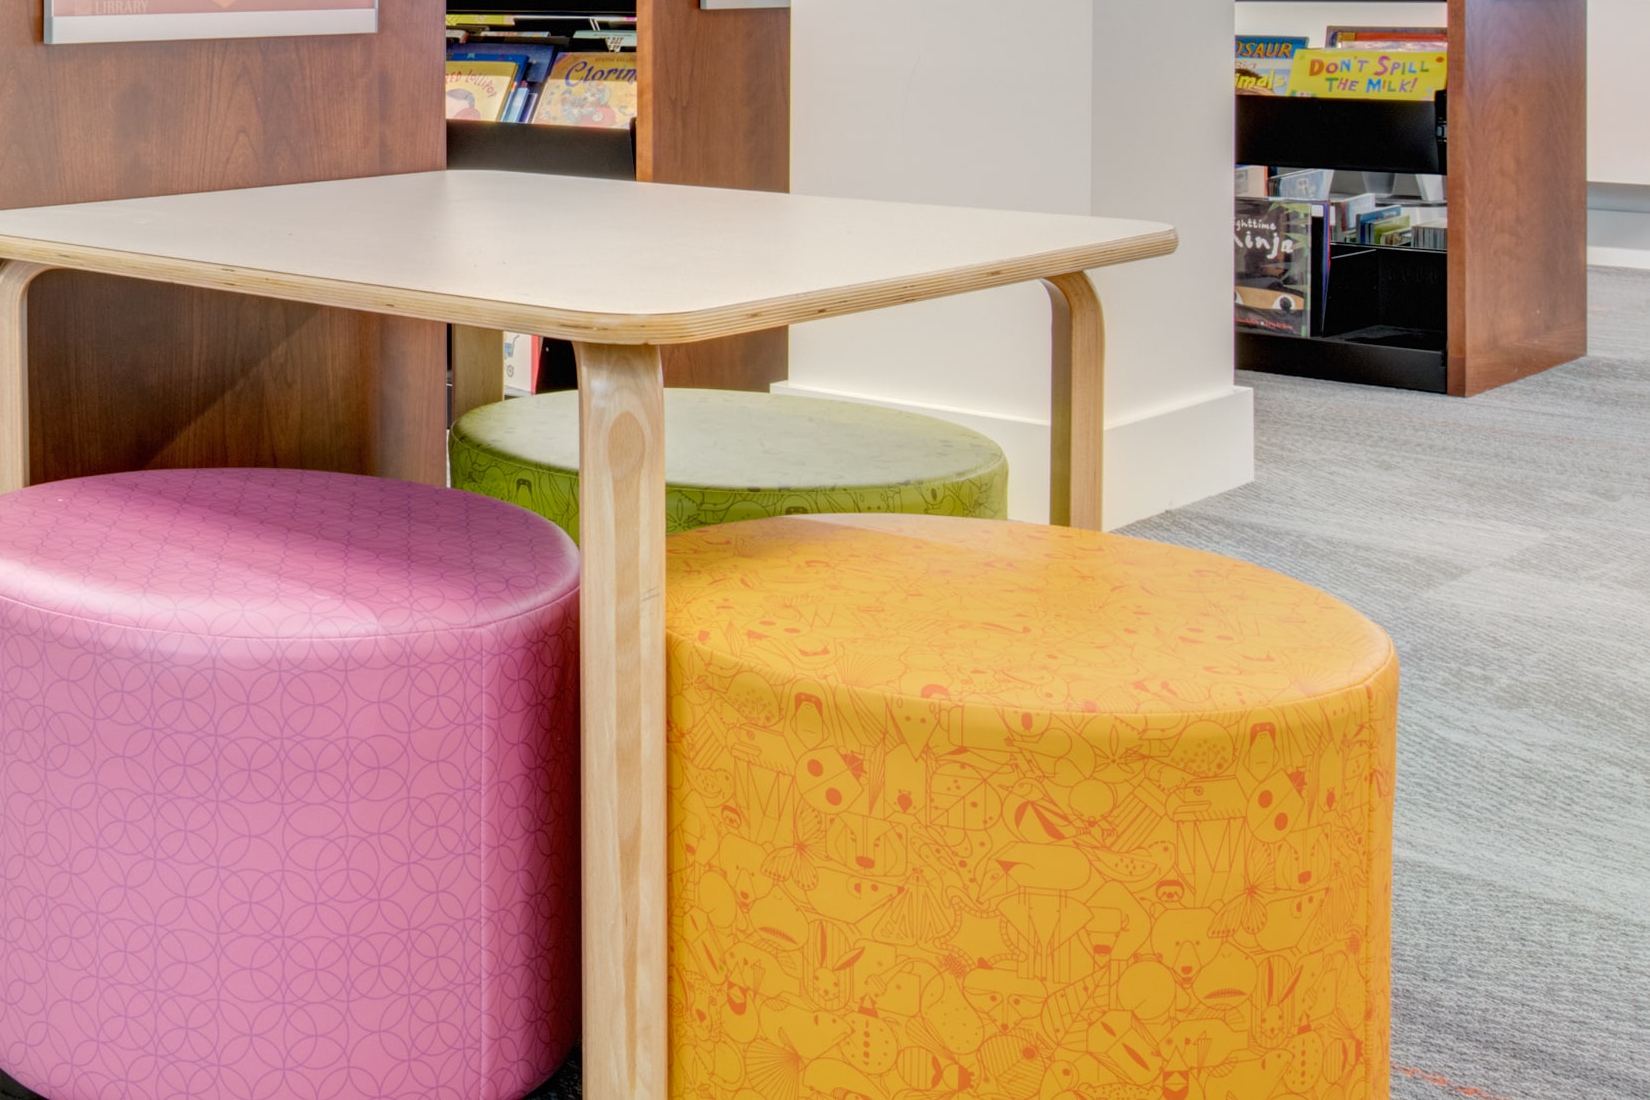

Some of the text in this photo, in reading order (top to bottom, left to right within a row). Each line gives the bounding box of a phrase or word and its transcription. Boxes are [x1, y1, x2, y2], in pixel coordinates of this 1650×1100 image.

[94, 0, 150, 15] LIBRARY
[564, 60, 637, 88] Clorin
[1308, 55, 1430, 77] DON'T SPILL
[1325, 77, 1419, 94] THE MILK!
